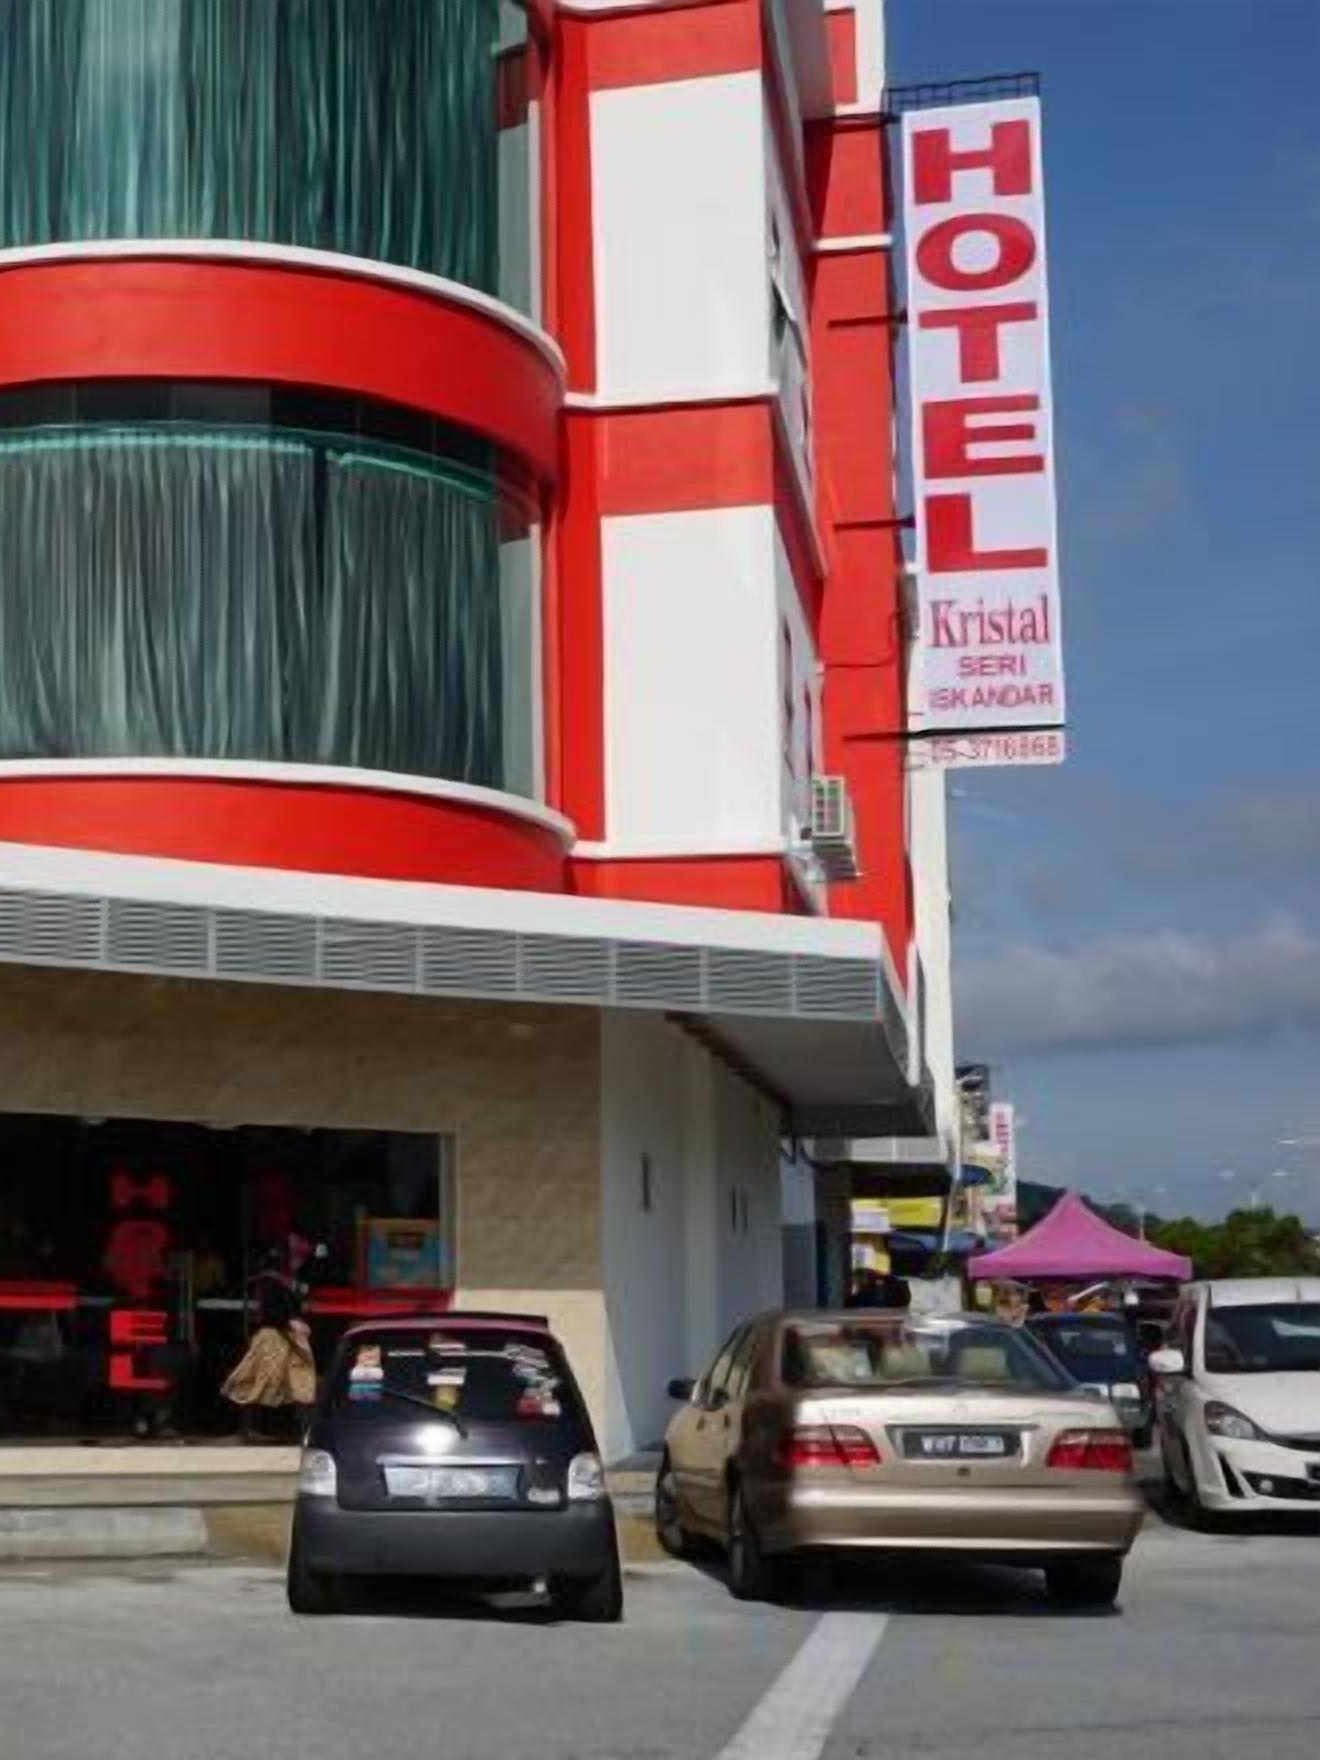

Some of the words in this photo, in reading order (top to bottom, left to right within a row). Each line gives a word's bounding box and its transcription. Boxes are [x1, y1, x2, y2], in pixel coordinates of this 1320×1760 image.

[911, 118, 1047, 572] HOTEL
[930, 594, 1051, 648] Kristal
[958, 655, 1027, 677] SERI
